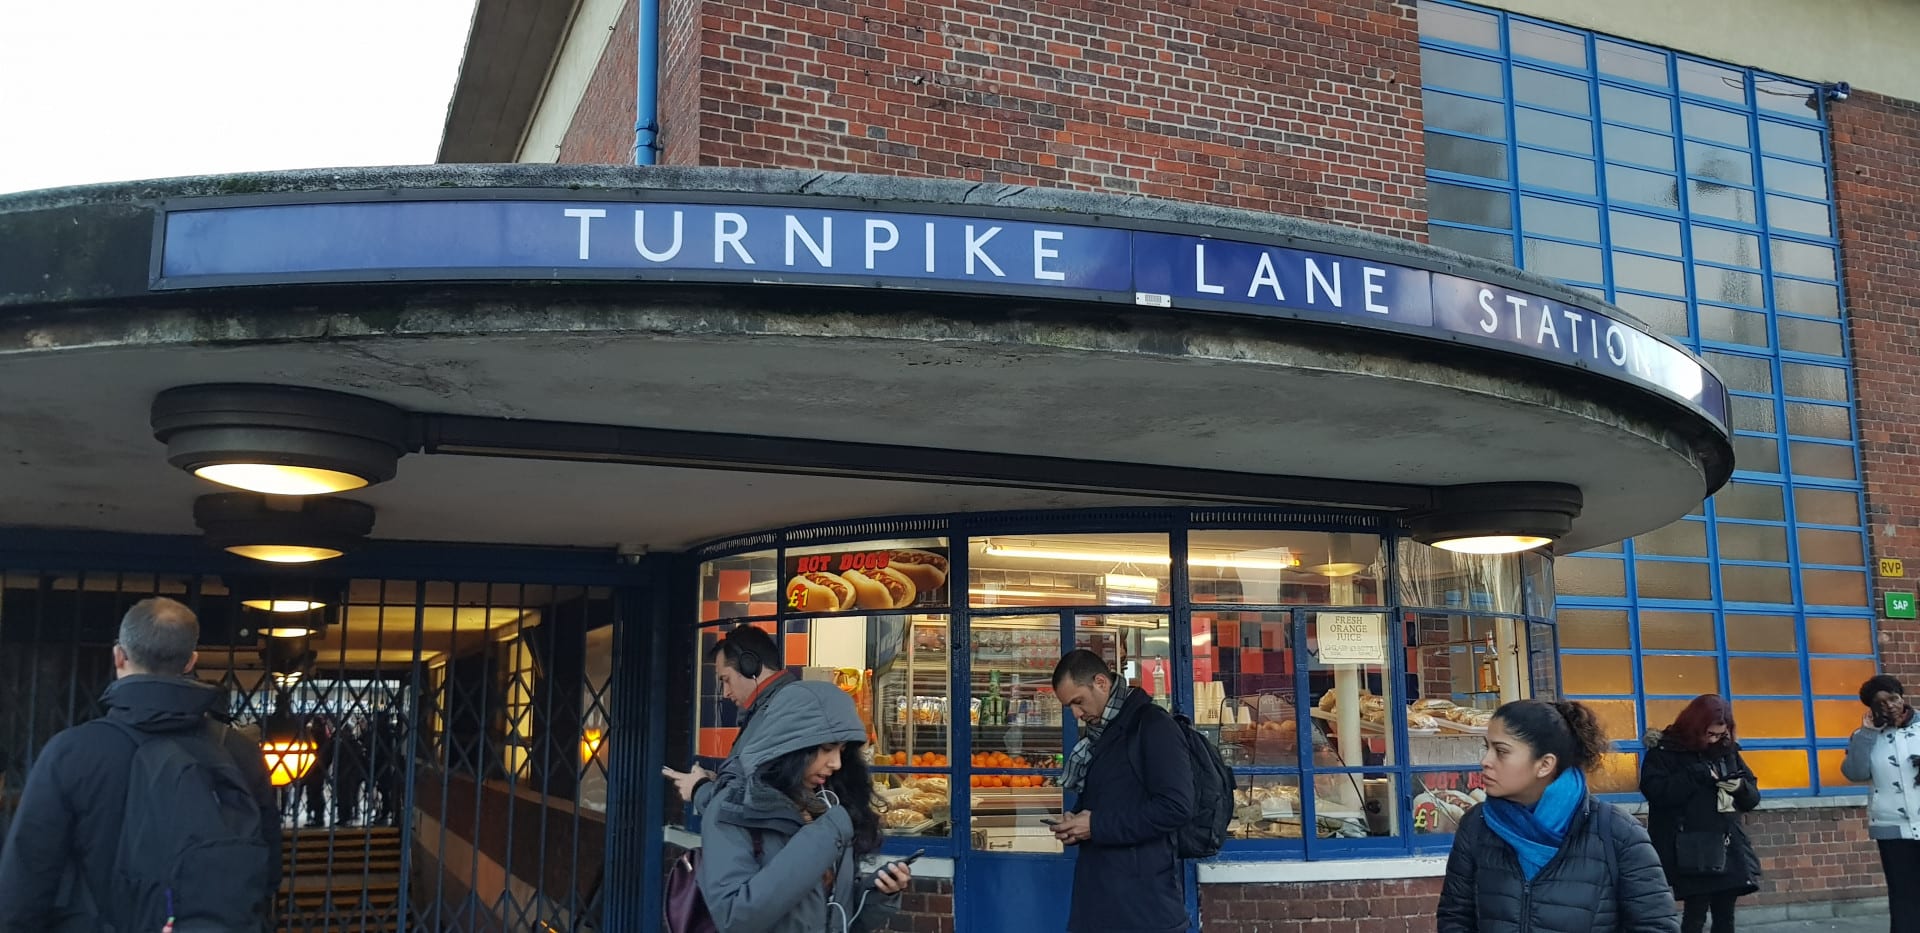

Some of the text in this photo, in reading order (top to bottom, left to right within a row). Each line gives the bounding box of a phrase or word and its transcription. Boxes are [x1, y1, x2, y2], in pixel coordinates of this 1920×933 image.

[564, 208, 1652, 378] TURNPIKE LANE STATION
[798, 551, 890, 573] HOT DOGS
[1881, 562, 1901, 573] RVP
[788, 588, 810, 607] £1
[1893, 600, 1909, 610] SAP
[1335, 615, 1363, 624] FRESH
[1330, 624, 1367, 633] ORANGE
[1336, 632, 1362, 641] JUICE
[1414, 808, 1439, 828] £1
